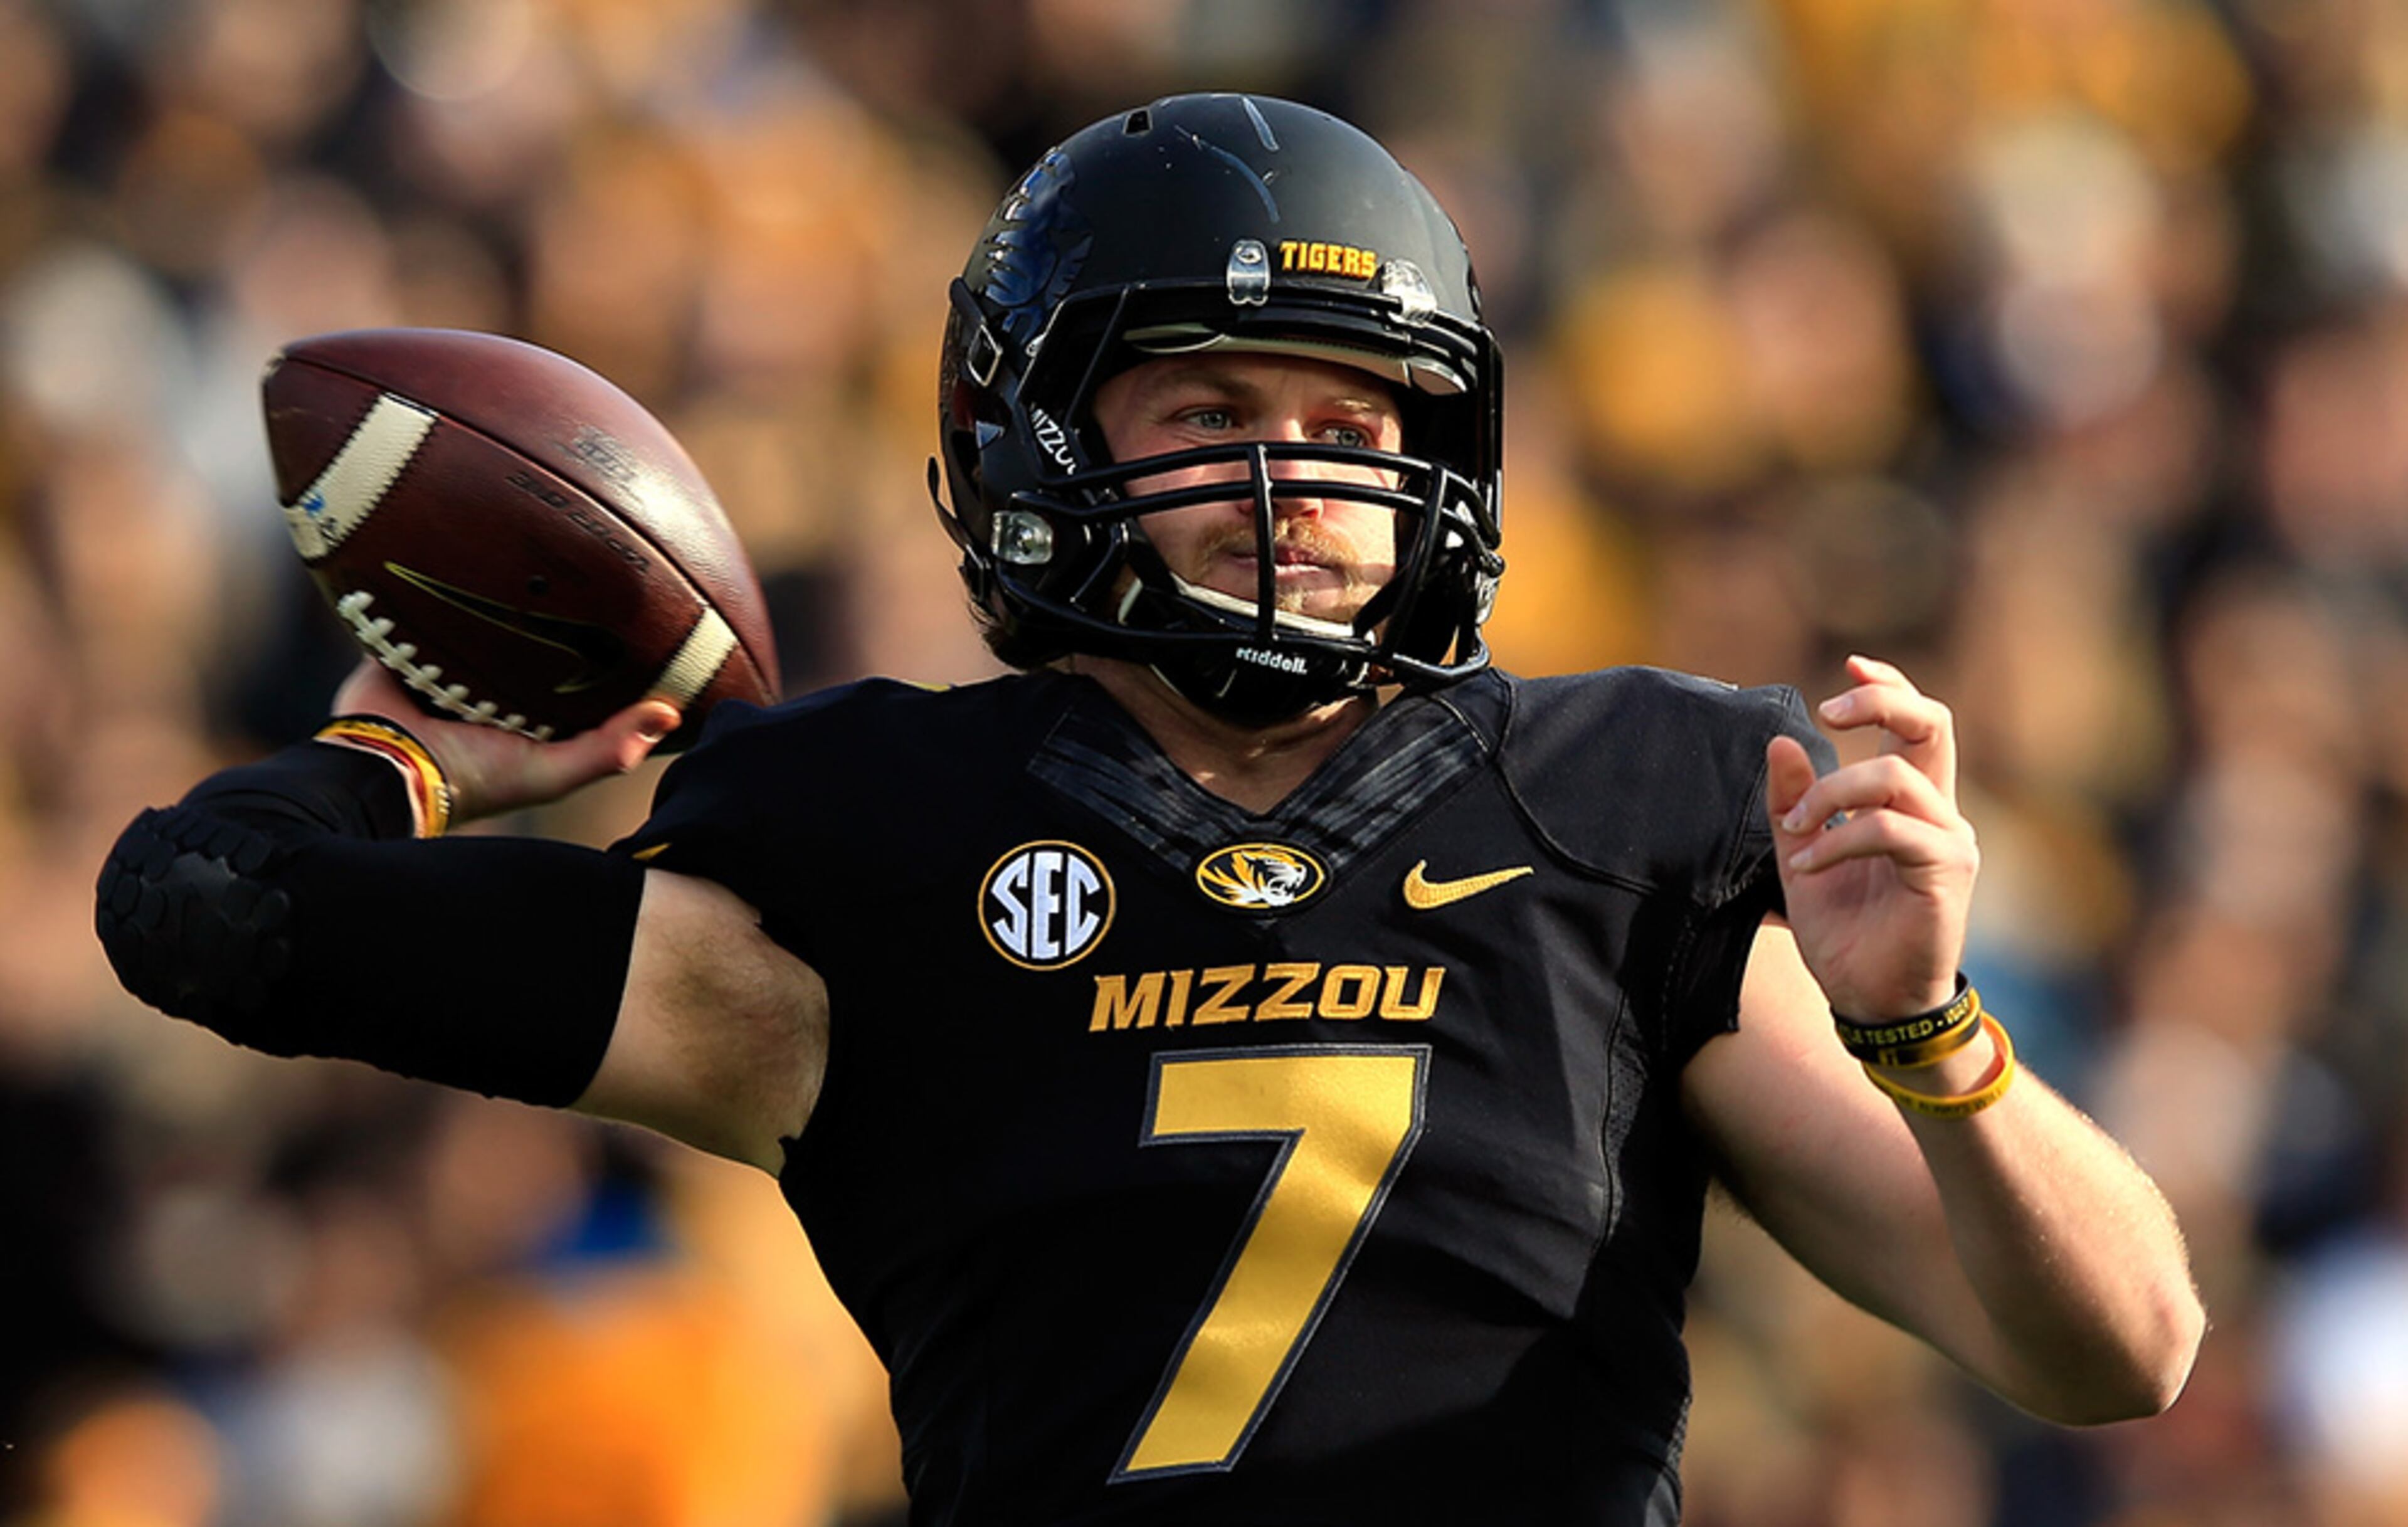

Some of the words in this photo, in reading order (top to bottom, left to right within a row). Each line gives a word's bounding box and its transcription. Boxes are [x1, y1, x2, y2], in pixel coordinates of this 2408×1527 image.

[1279, 240, 1377, 280] TIGERS
[991, 851, 1101, 959] SEC
[1089, 963, 1445, 1032] MIZZOU
[1106, 1044, 1432, 1484] 7
